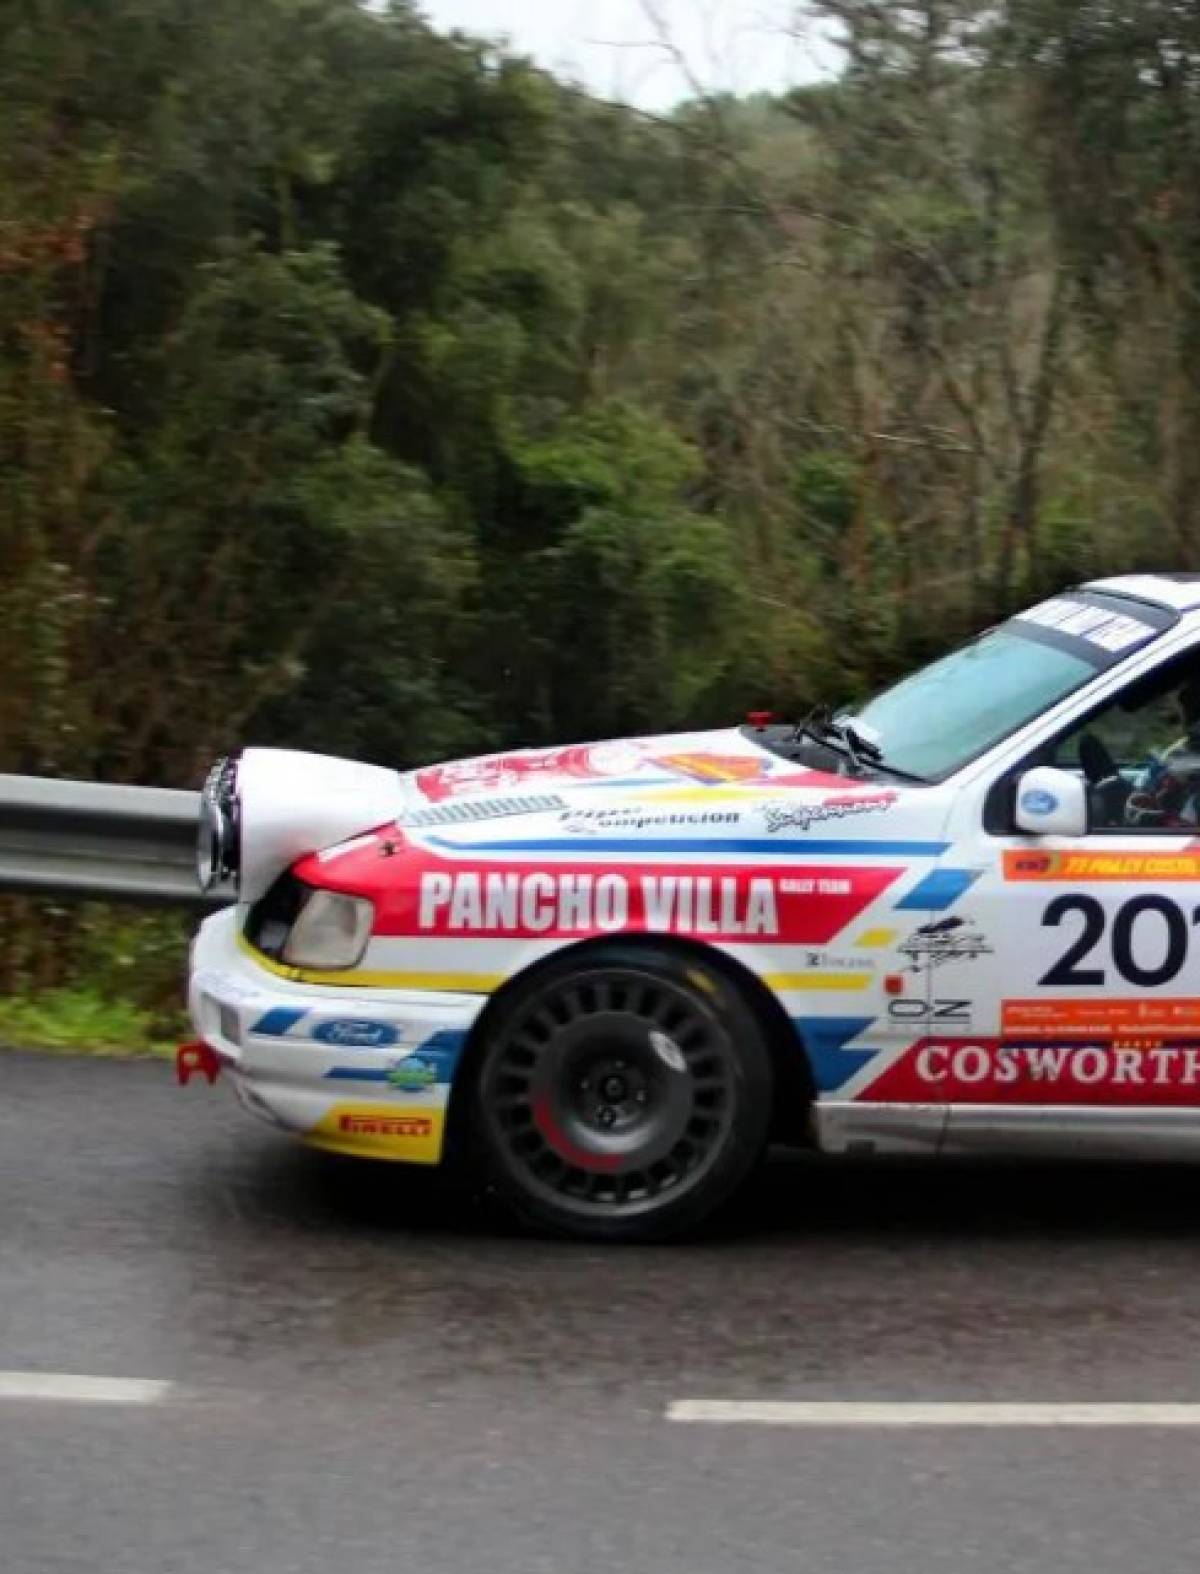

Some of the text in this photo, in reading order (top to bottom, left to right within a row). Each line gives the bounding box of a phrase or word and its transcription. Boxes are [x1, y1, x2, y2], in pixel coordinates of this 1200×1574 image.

[418, 871, 629, 931] PANCHO
[641, 875, 780, 935] VILLA
[888, 999, 973, 1018] OZ
[338, 1114, 433, 1137] PIRELLI
